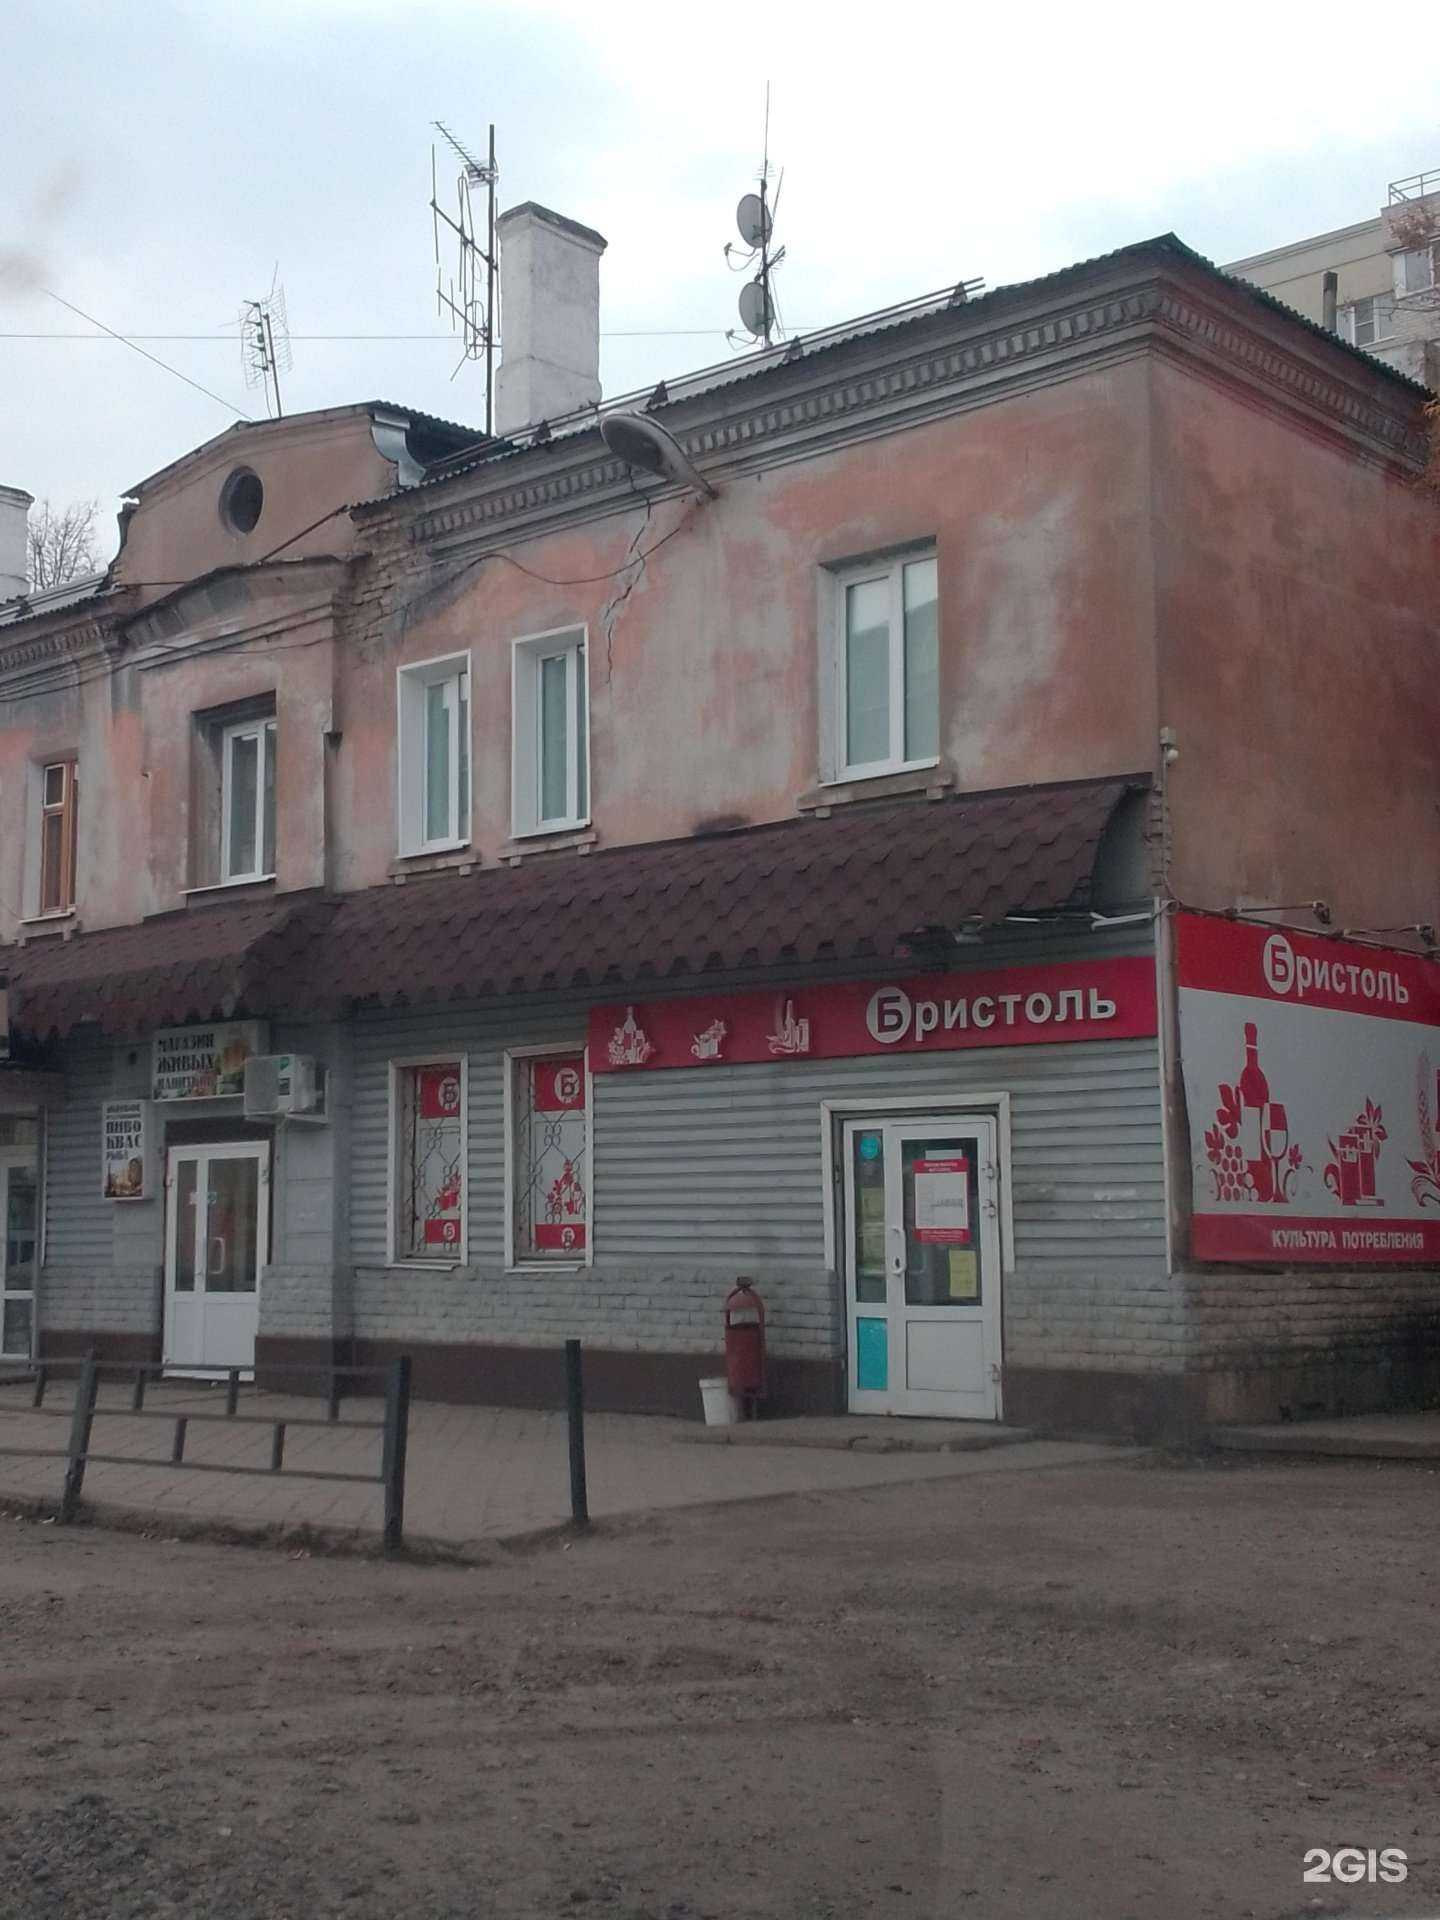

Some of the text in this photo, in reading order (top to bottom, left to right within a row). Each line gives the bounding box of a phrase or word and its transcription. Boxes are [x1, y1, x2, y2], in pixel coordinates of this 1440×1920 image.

[1265, 936, 1409, 1004] Бристоль
[869, 987, 1117, 1042] Бристоль
[158, 1033, 214, 1052] МАГАЗИН
[157, 1053, 215, 1073] ЖИВЫХ
[559, 1071, 580, 1100] Б
[106, 1120, 142, 1134] ПИВО
[106, 1134, 143, 1149] КВАС
[1272, 1229, 1424, 1249] КУЛЬТУРА ПОТРЕБЛЕНИЯ
